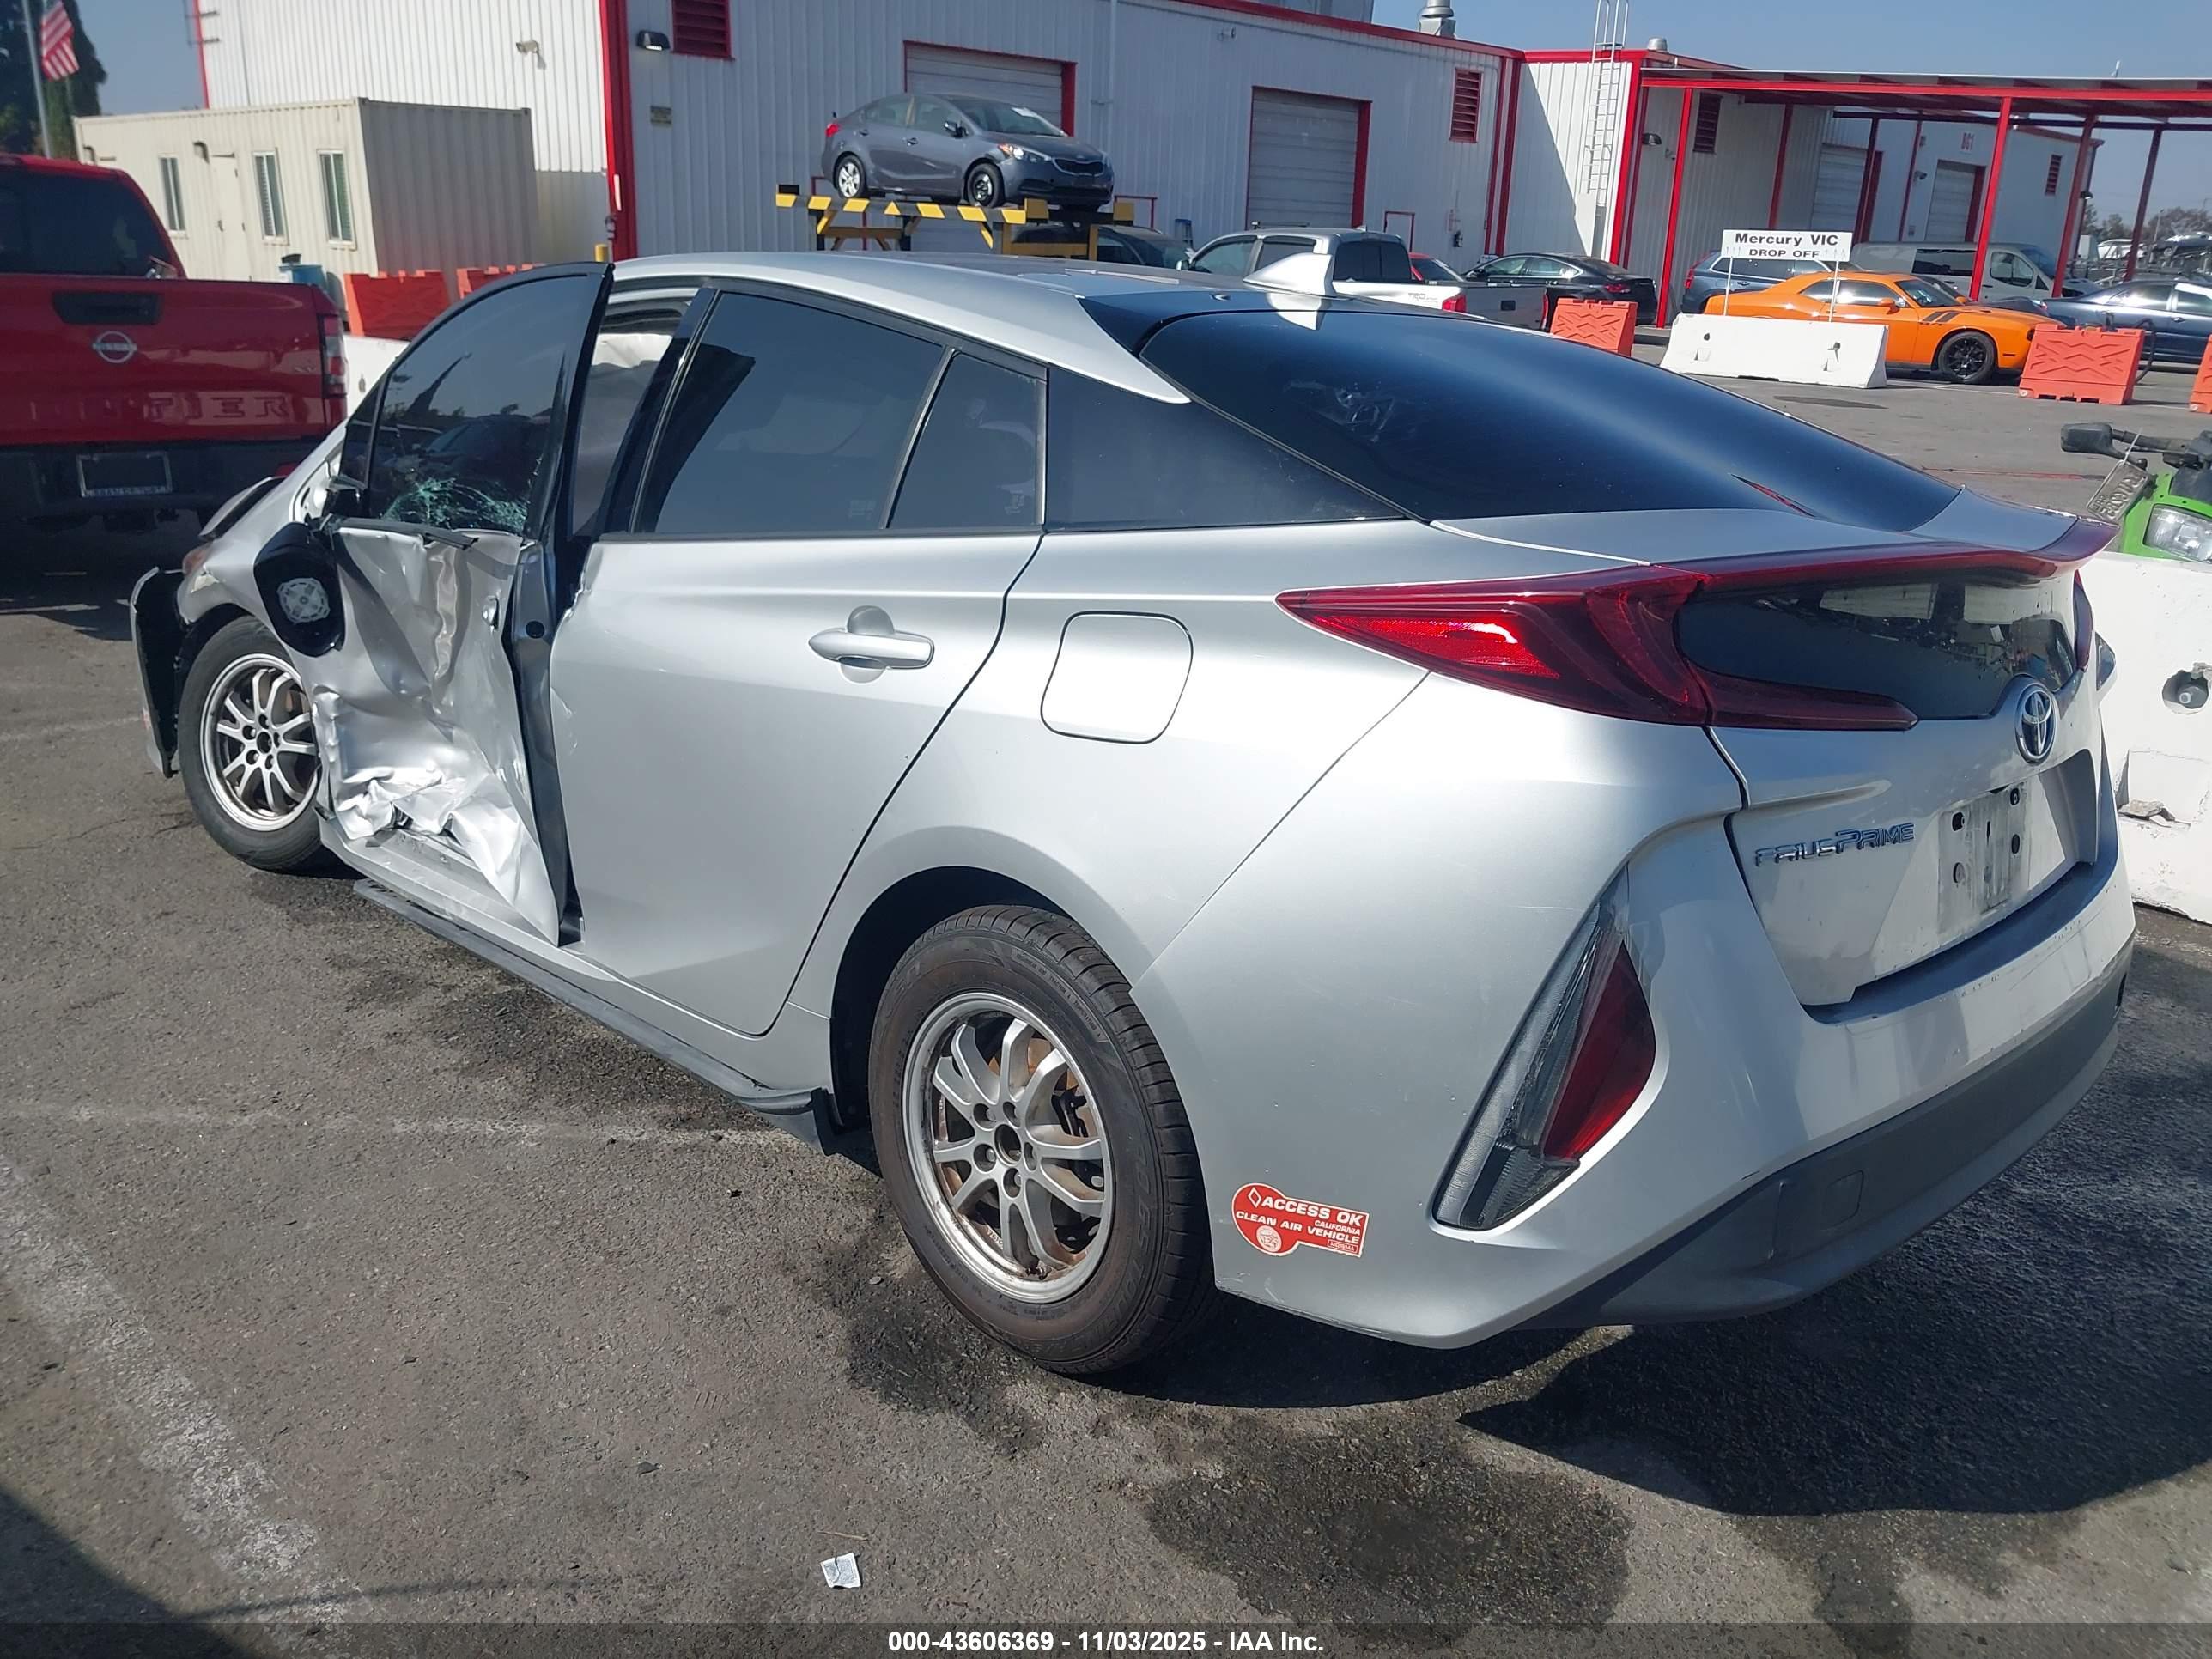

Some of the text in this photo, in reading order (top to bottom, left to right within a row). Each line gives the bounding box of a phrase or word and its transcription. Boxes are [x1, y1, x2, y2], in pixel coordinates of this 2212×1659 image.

[1735, 233, 1839, 247] Mercury VIC
[1749, 249, 1820, 258] DROP OFF
[1835, 822, 1915, 856] PRIME
[1261, 1196, 1364, 1227] ACCESS OK
[1236, 1211, 1360, 1244] CLEAN AIR VEHICLE
[1314, 1220, 1361, 1236] CALIFORNIA
